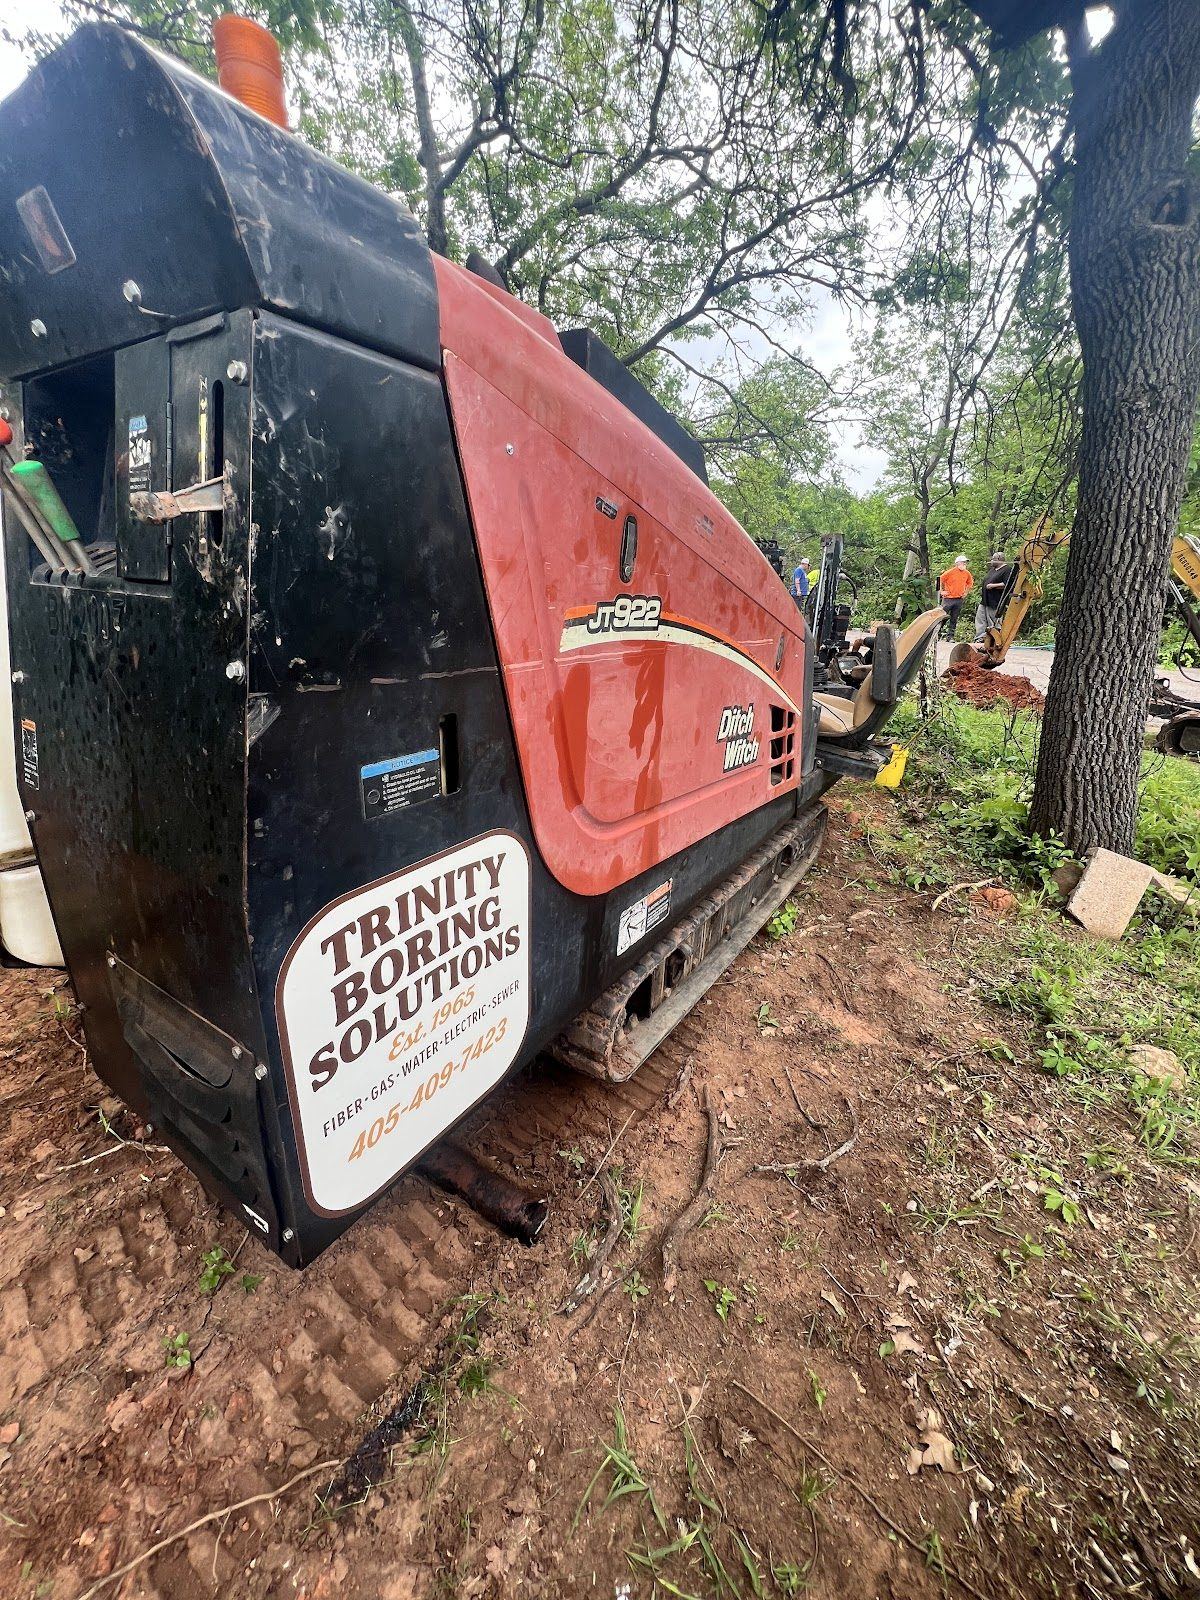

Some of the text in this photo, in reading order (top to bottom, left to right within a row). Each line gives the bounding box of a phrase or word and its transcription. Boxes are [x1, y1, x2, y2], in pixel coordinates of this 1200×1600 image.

[587, 596, 662, 632] JT922
[717, 704, 755, 741] Ditch
[723, 736, 760, 772] Witch
[321, 852, 507, 977] TRINITY
[330, 895, 503, 1027] BORING
[309, 925, 521, 1093] SOLUTIONS
[388, 984, 476, 1062] Est. 1965
[348, 1017, 508, 1162] 405-409-7423
